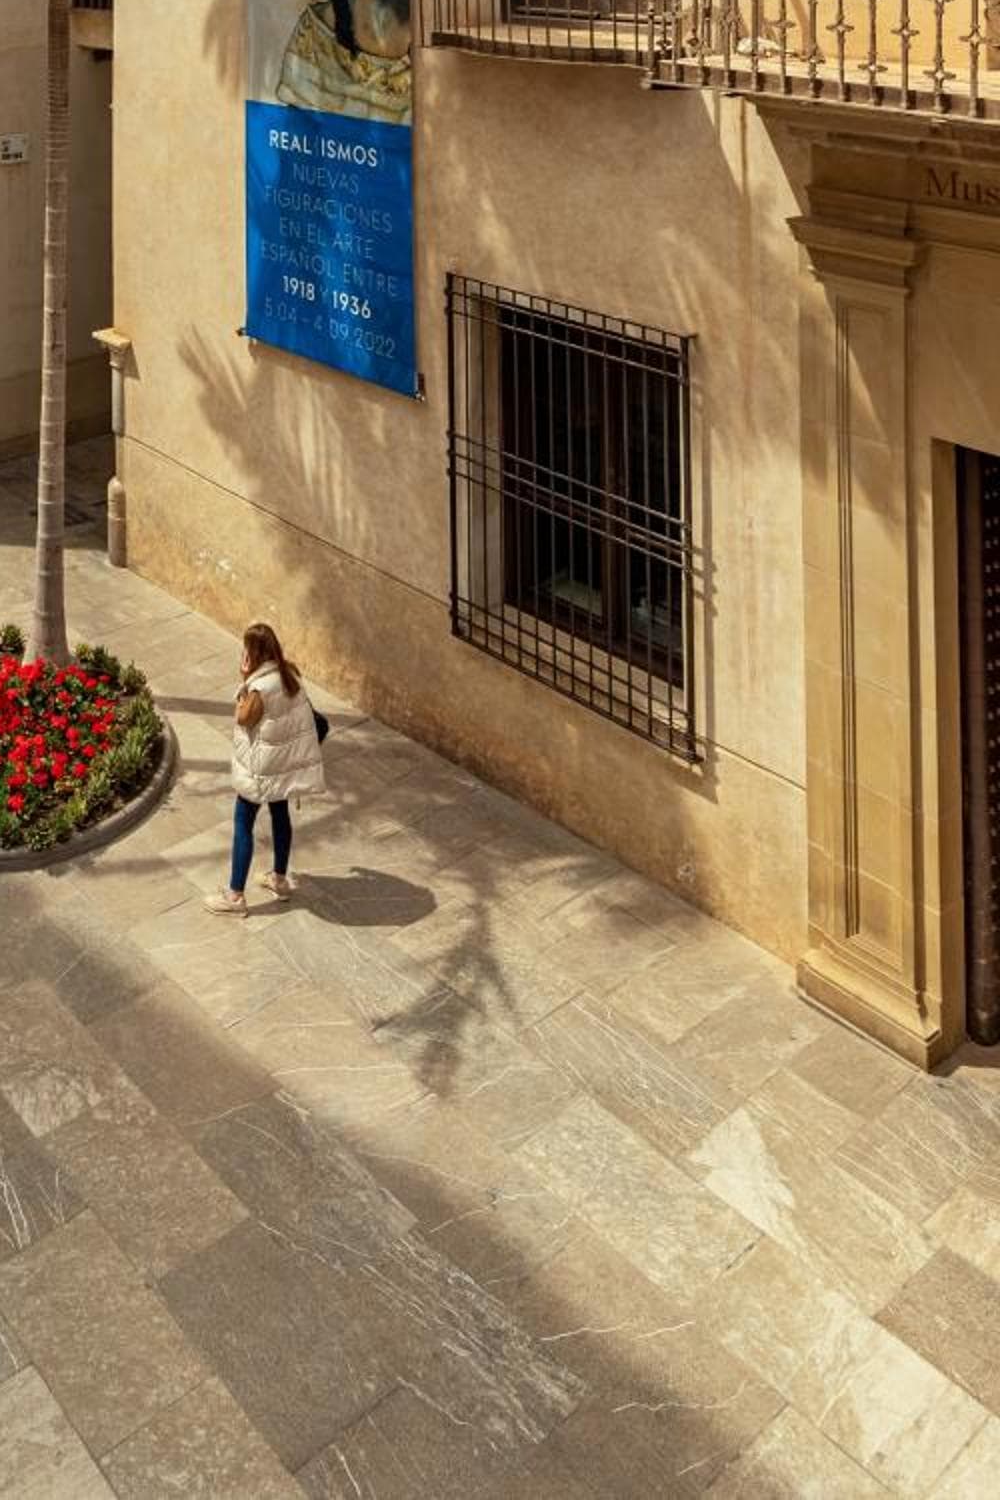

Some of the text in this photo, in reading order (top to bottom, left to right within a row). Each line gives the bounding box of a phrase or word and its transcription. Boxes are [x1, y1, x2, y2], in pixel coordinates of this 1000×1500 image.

[293, 163, 359, 195] NUEVAS
[265, 185, 392, 234] FIGURACIONES
[280, 217, 374, 260] EN EL ARTE
[283, 275, 315, 302] 1918
[332, 290, 372, 319] 1936
[343, 263, 398, 298] ENTRE
